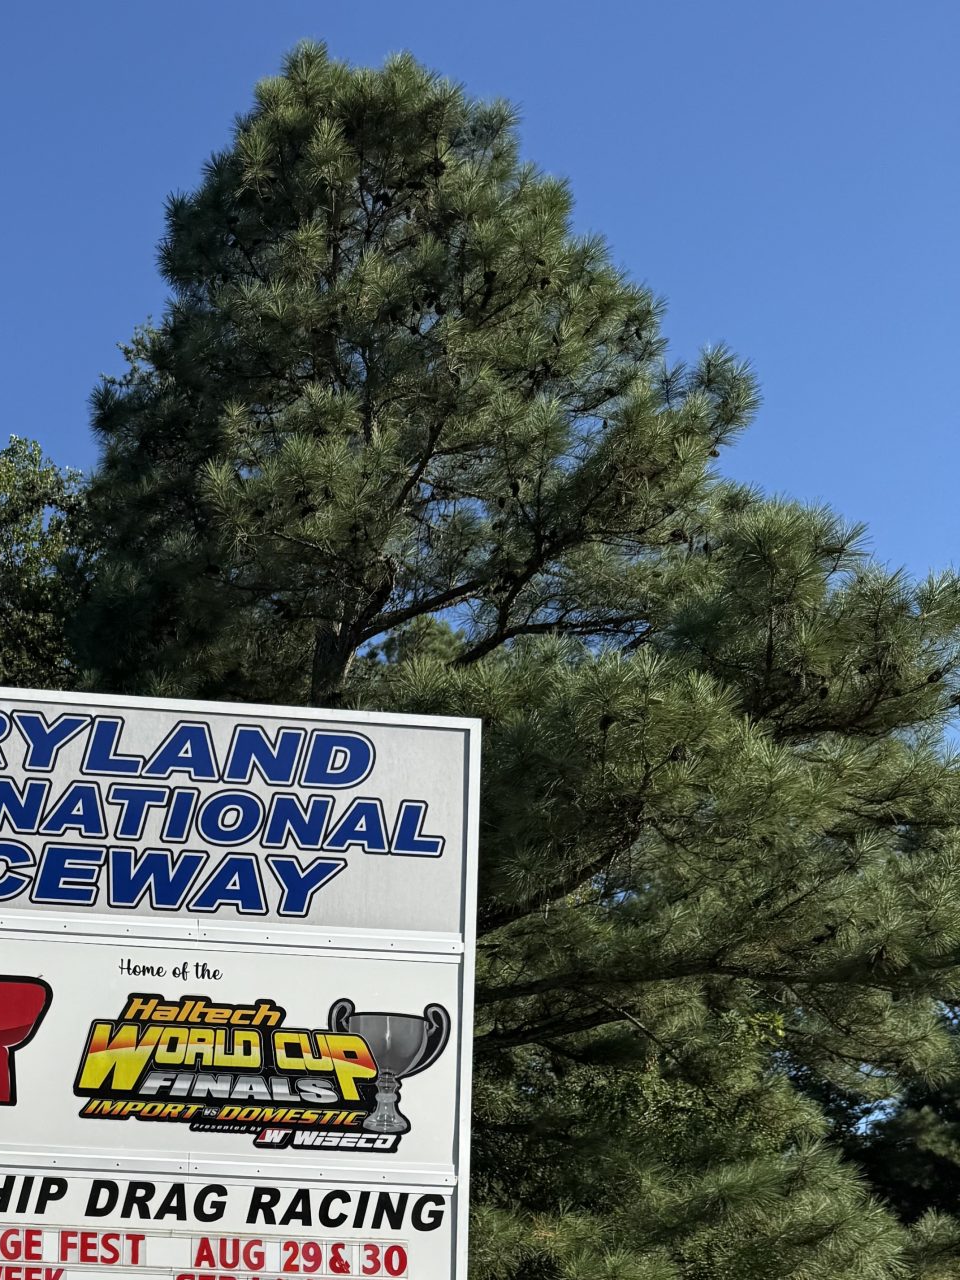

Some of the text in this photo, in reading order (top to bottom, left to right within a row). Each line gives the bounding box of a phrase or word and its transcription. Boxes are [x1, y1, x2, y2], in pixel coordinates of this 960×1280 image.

[119, 958, 223, 981] Home of the
[124, 998, 281, 1026] Haltech
[79, 1023, 378, 1101] WORLD CUP
[139, 1072, 338, 1103] FINALS
[84, 1099, 204, 1119] IMPORT
[217, 1106, 367, 1126] DOMESTIC
[84, 1179, 228, 1223] DRAG
[246, 1187, 445, 1232] RACING
[60, 1231, 145, 1265] FEST
[194, 1237, 265, 1271] AUG
[362, 1244, 408, 1277] 30
